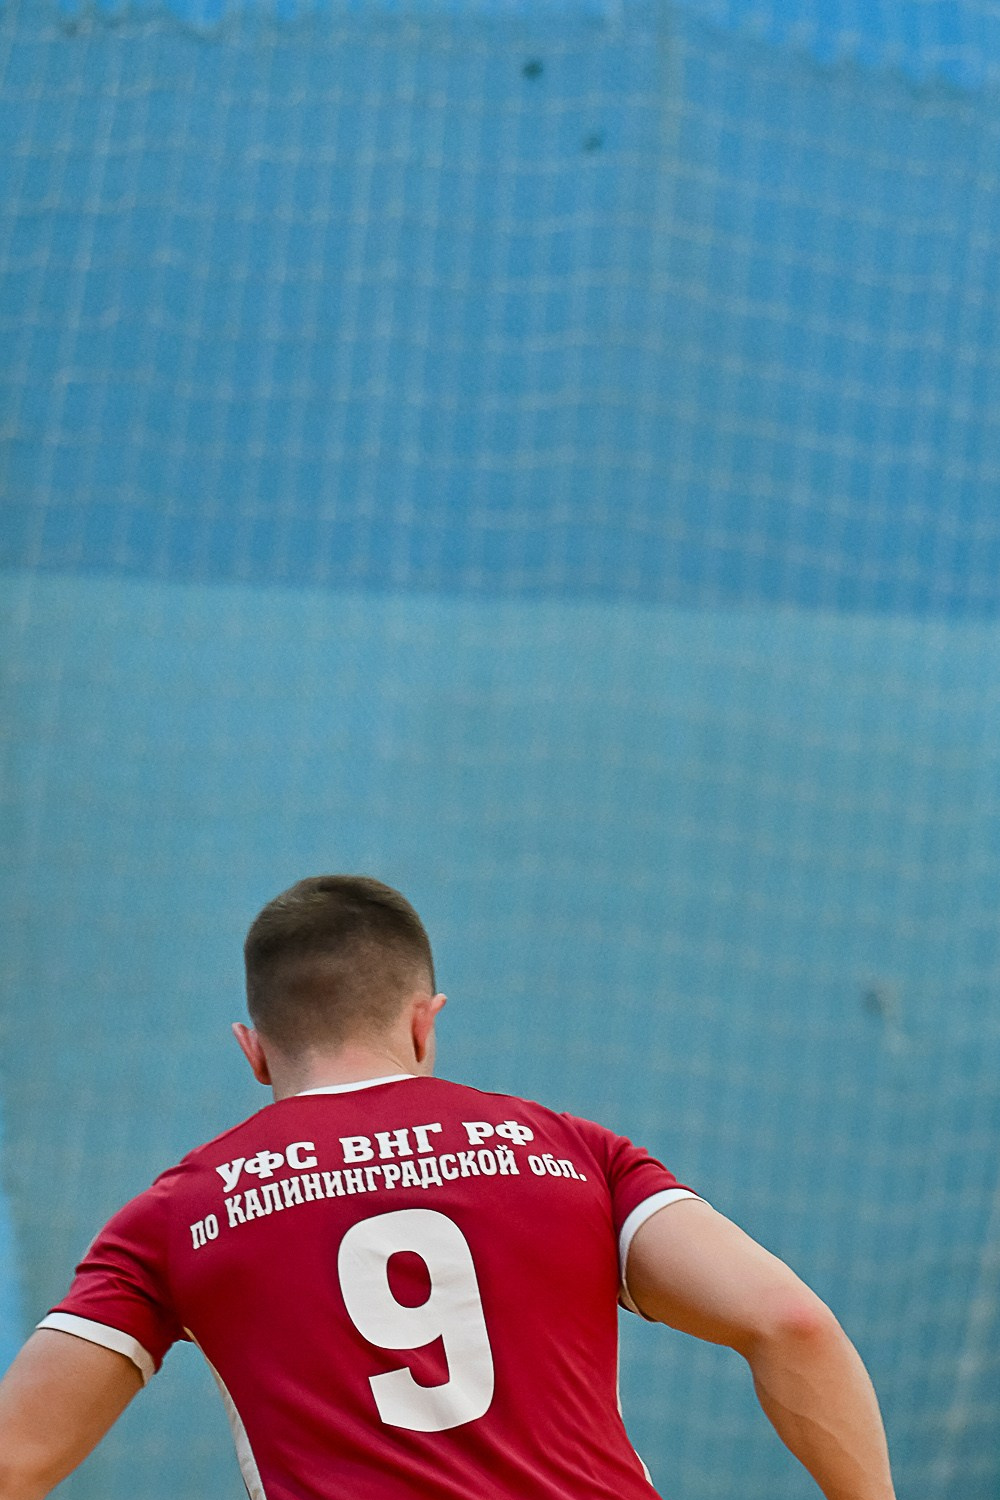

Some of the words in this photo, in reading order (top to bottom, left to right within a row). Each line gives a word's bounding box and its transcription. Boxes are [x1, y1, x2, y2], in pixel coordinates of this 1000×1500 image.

[215, 1141, 318, 1193] УФС
[339, 1122, 442, 1164] ВНГ
[462, 1120, 535, 1147] РФ
[224, 1144, 520, 1228] КАЛИНИНГРАДСКОЙ
[528, 1153, 588, 1182] обл.
[337, 1208, 495, 1433] 9
